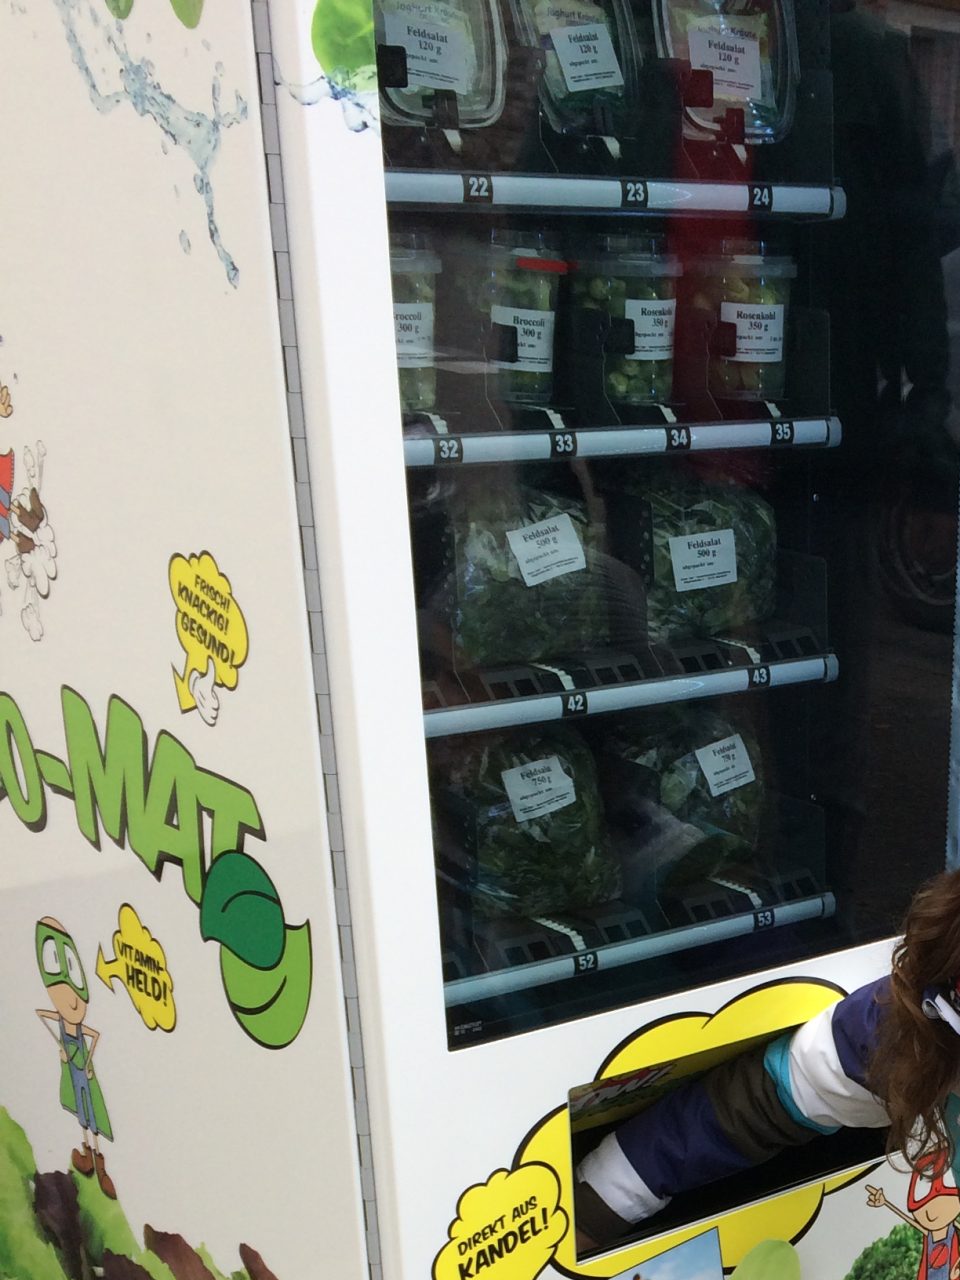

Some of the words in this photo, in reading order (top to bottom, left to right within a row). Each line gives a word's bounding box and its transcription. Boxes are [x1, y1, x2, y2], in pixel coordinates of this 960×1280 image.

[406, 26, 448, 43] Feldsalat
[568, 31, 599, 43] Feldsalat
[419, 40, 434, 51] 120
[579, 44, 592, 54] 120
[708, 40, 745, 54] Feldsalat
[719, 52, 732, 62] 120
[468, 176, 489, 197] 22
[626, 182, 645, 202] 23
[753, 187, 770, 207] 24
[394, 312, 422, 321] roccoli
[513, 315, 545, 327] Broccoli
[736, 310, 776, 321] Rosenkohl
[520, 328, 536, 338] 300
[748, 321, 762, 331] 350
[671, 429, 688, 447] 34
[775, 423, 791, 440] 35
[439, 440, 459, 459] 32
[555, 434, 574, 452] 33
[522, 525, 560, 542] Feldsalat
[536, 537, 551, 549] 500
[687, 538, 722, 549] Feldsalat
[697, 549, 710, 558] 500
[194, 574, 231, 613] FRISCH!
[178, 581, 230, 635] KNACKIG!
[181, 611, 236, 669] GESUND!
[752, 669, 768, 684] 43
[567, 694, 584, 712] 42
[757, 911, 773, 926] 53
[116, 938, 165, 975] VITAMIN-
[578, 954, 595, 969] 52
[125, 962, 168, 1007] HELD!
[457, 1214, 507, 1256] DIREKT
[512, 1195, 538, 1222] AUS
